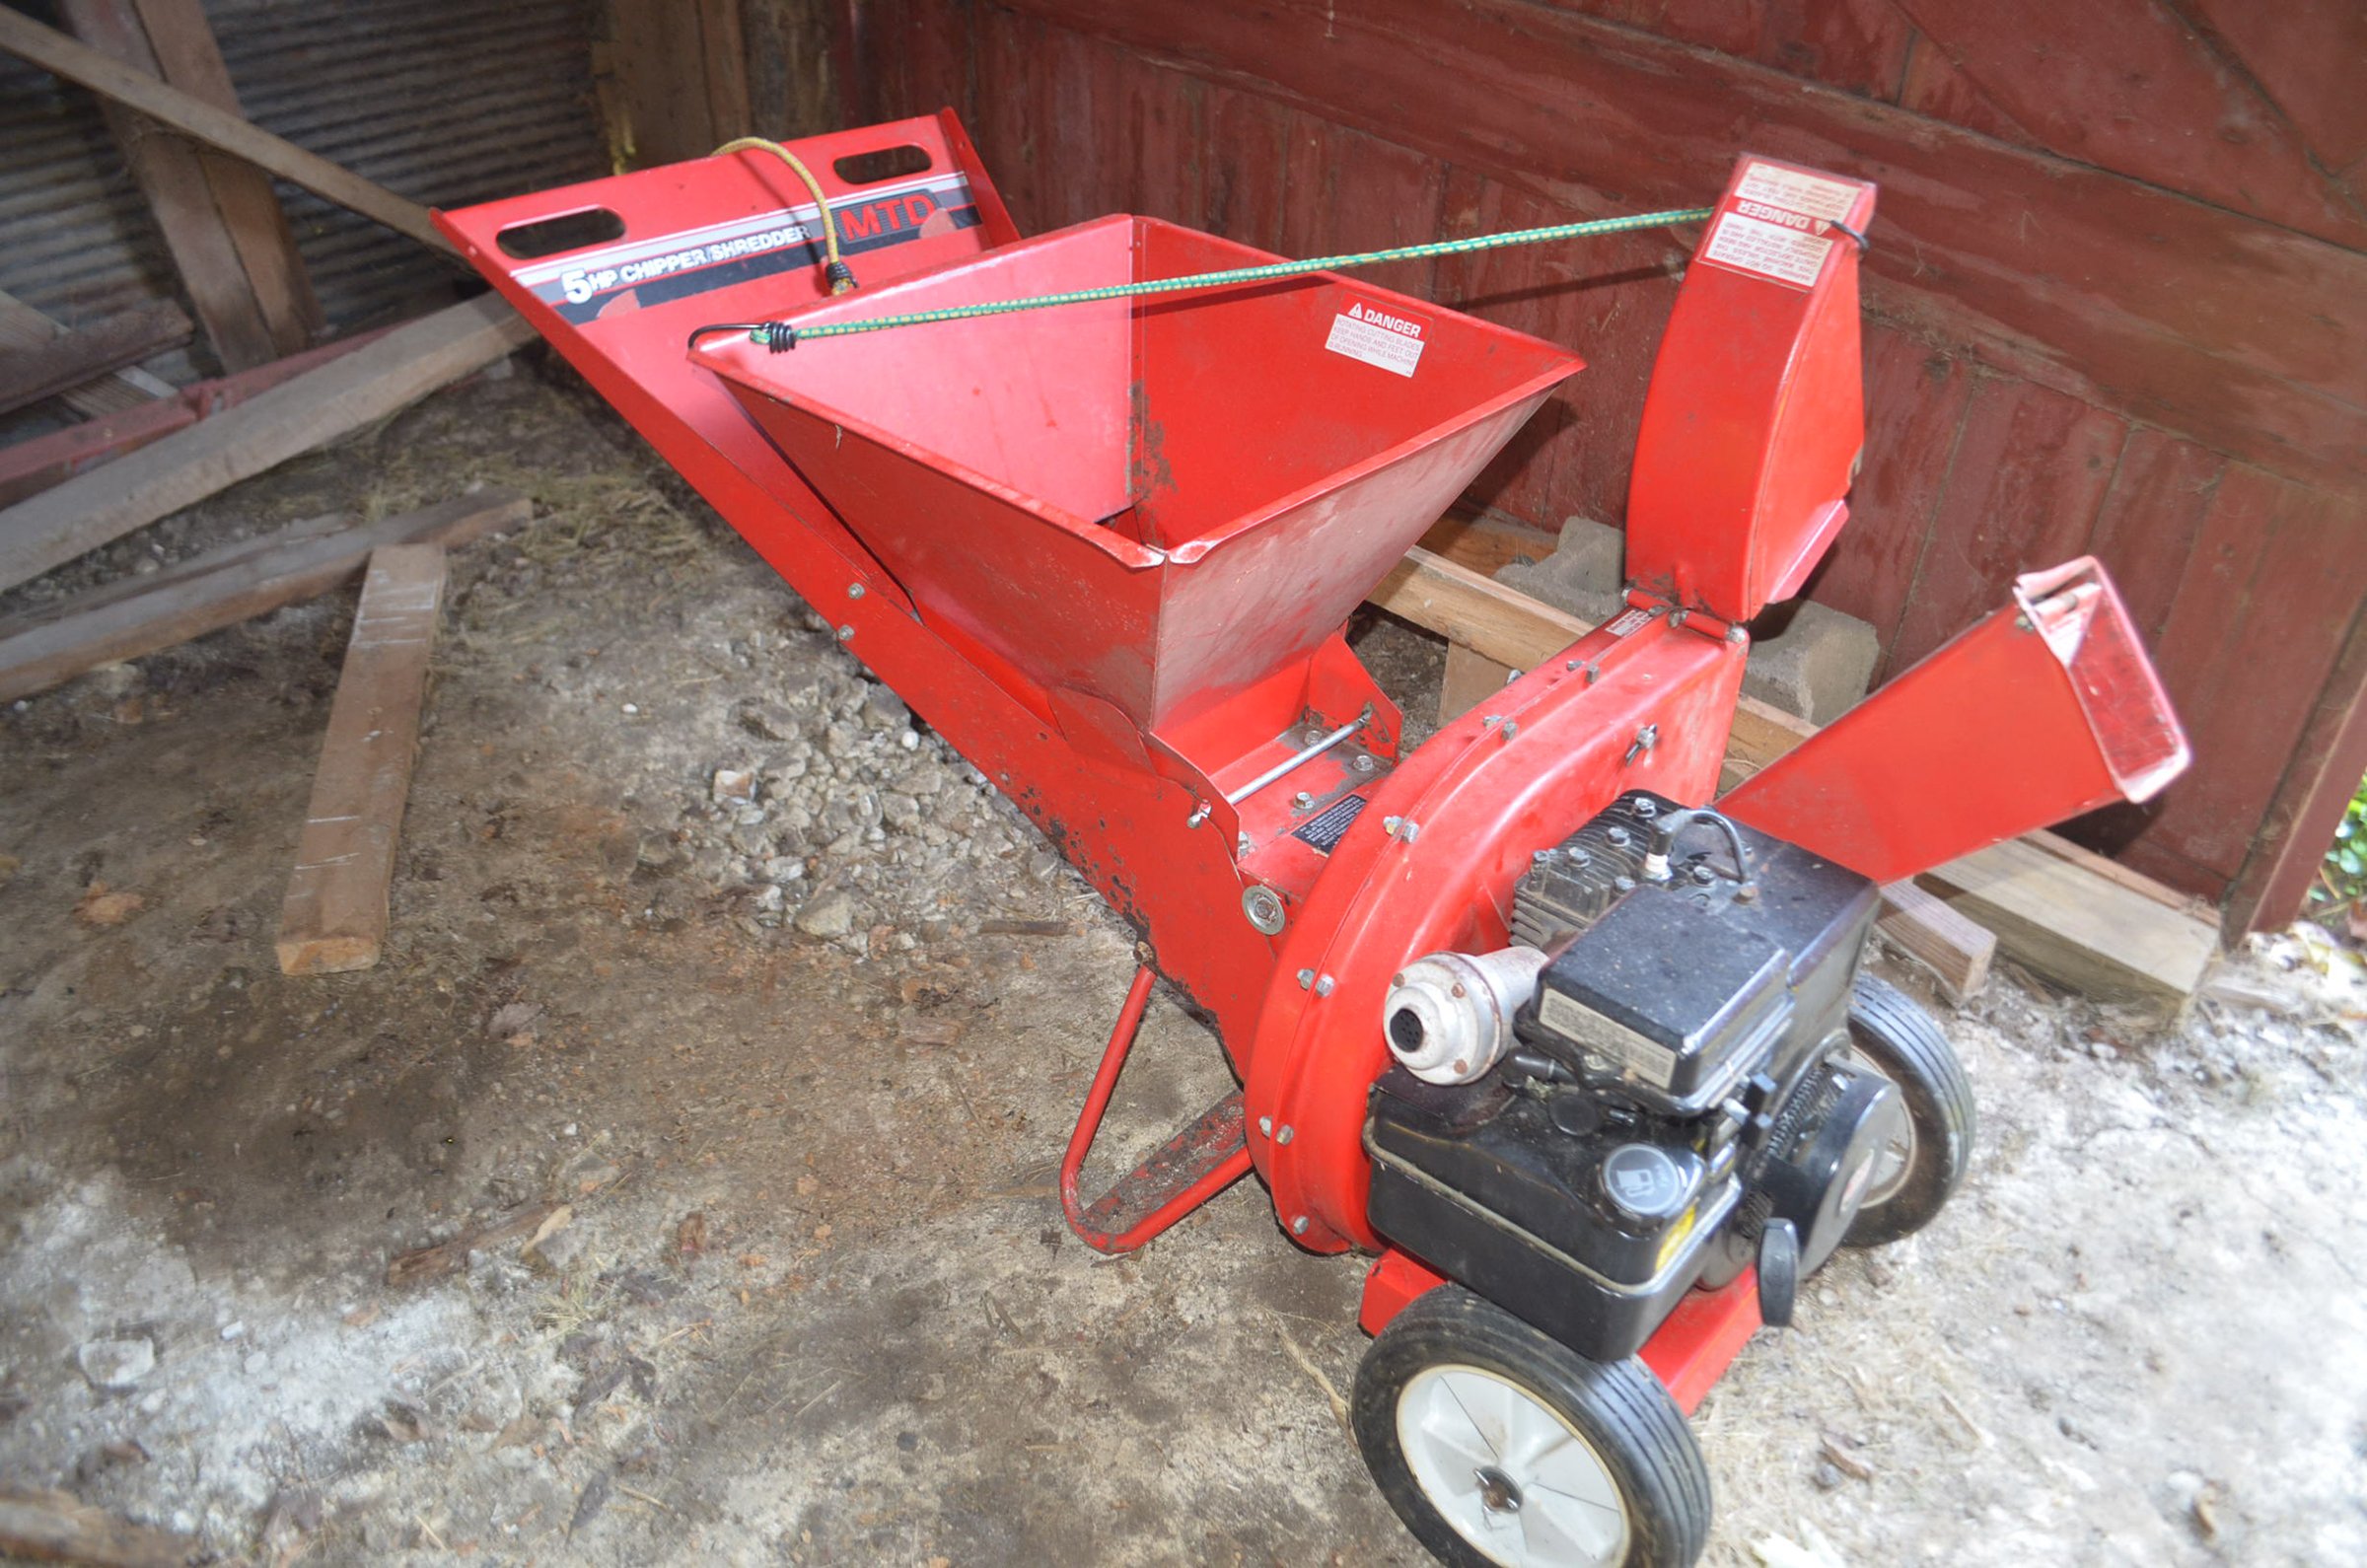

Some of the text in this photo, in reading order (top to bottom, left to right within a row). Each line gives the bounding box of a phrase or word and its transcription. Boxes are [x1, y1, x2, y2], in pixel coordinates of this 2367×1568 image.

[839, 194, 936, 242] MTD
[1736, 200, 1811, 230] DANGER
[561, 268, 593, 305] 5
[588, 269, 618, 291] HP
[1363, 309, 1421, 337] DANGER
